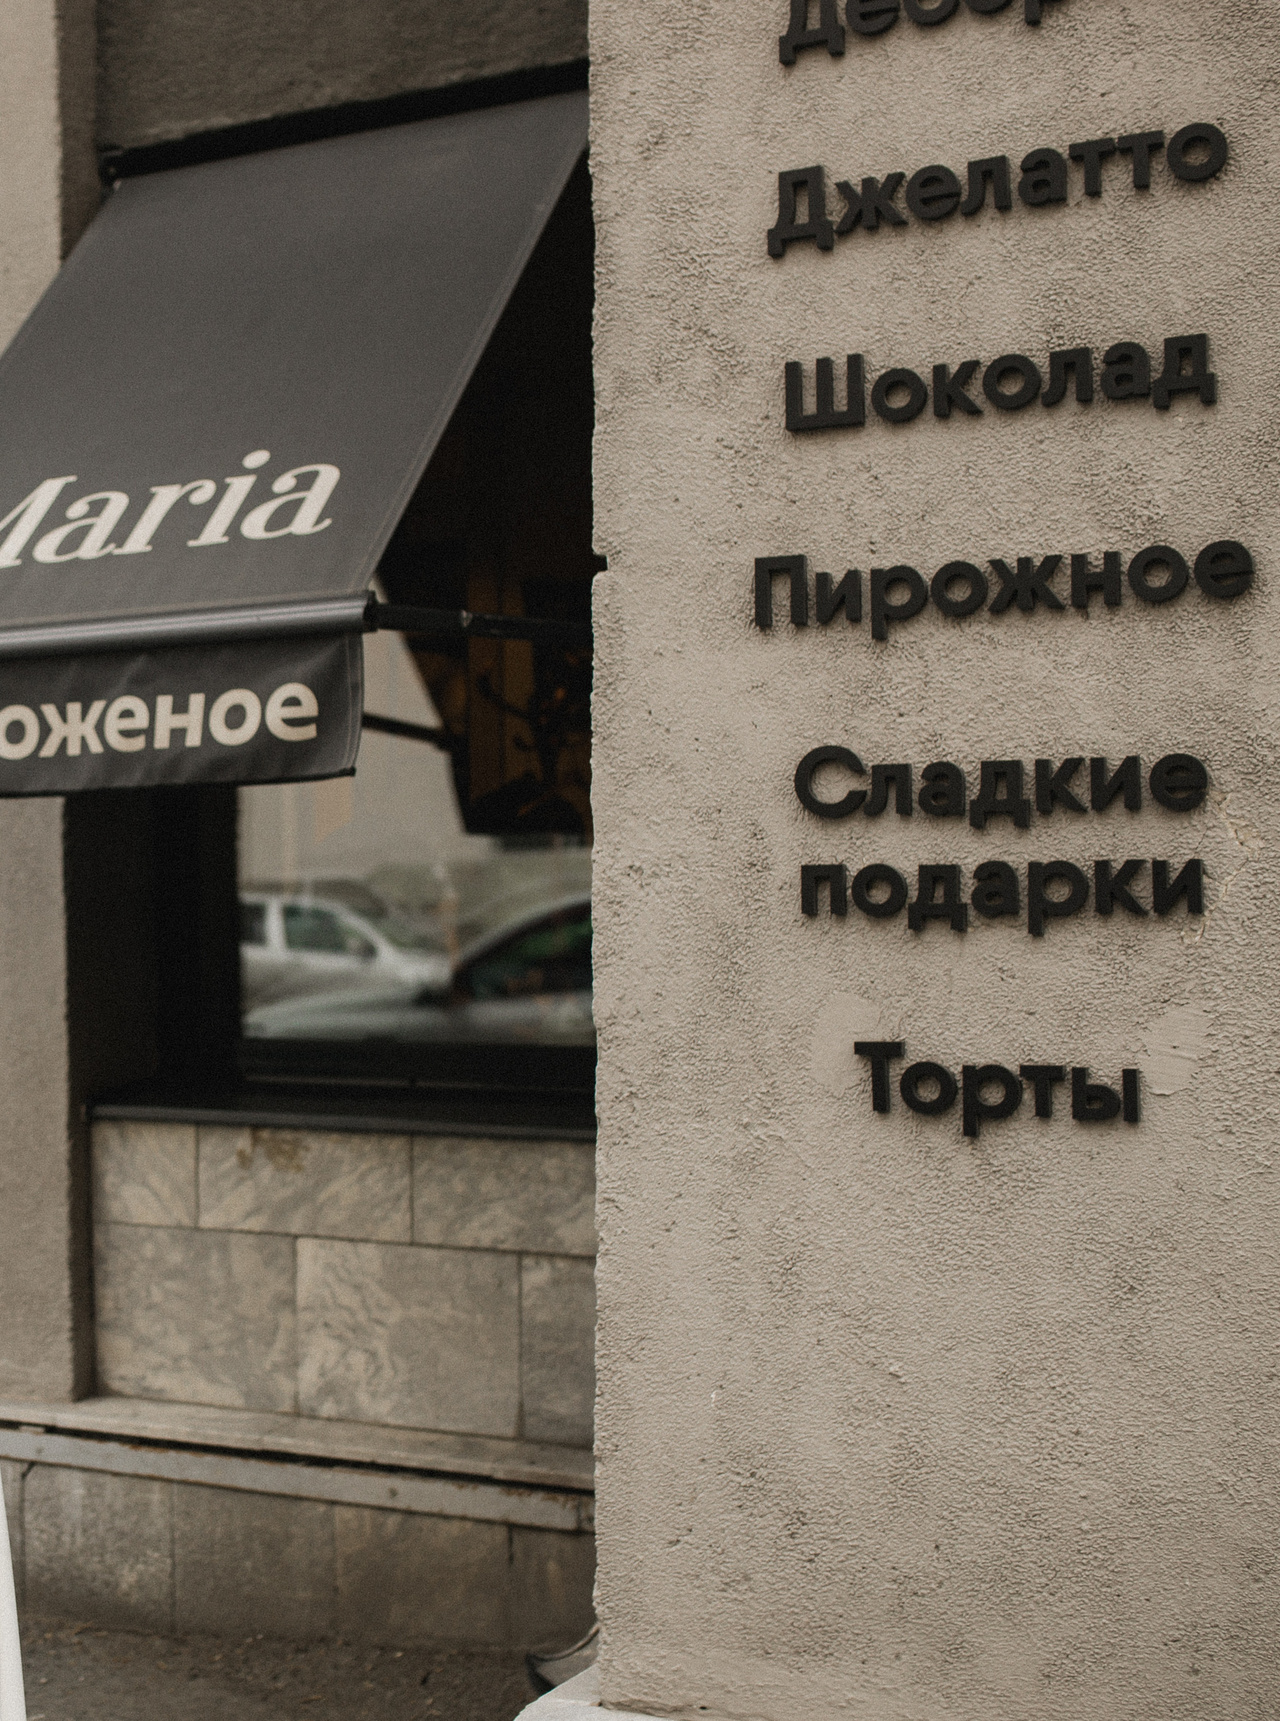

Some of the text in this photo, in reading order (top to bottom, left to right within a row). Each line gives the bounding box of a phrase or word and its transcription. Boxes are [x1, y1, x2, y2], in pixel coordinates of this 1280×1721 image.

[767, 122, 1228, 258] Джелатто
[784, 333, 1218, 433] Шоколад
[754, 540, 1255, 641] Пирожное
[794, 745, 1209, 830] Сладкие
[800, 858, 1205, 937] подарки
[853, 1041, 1141, 1138] Торты
